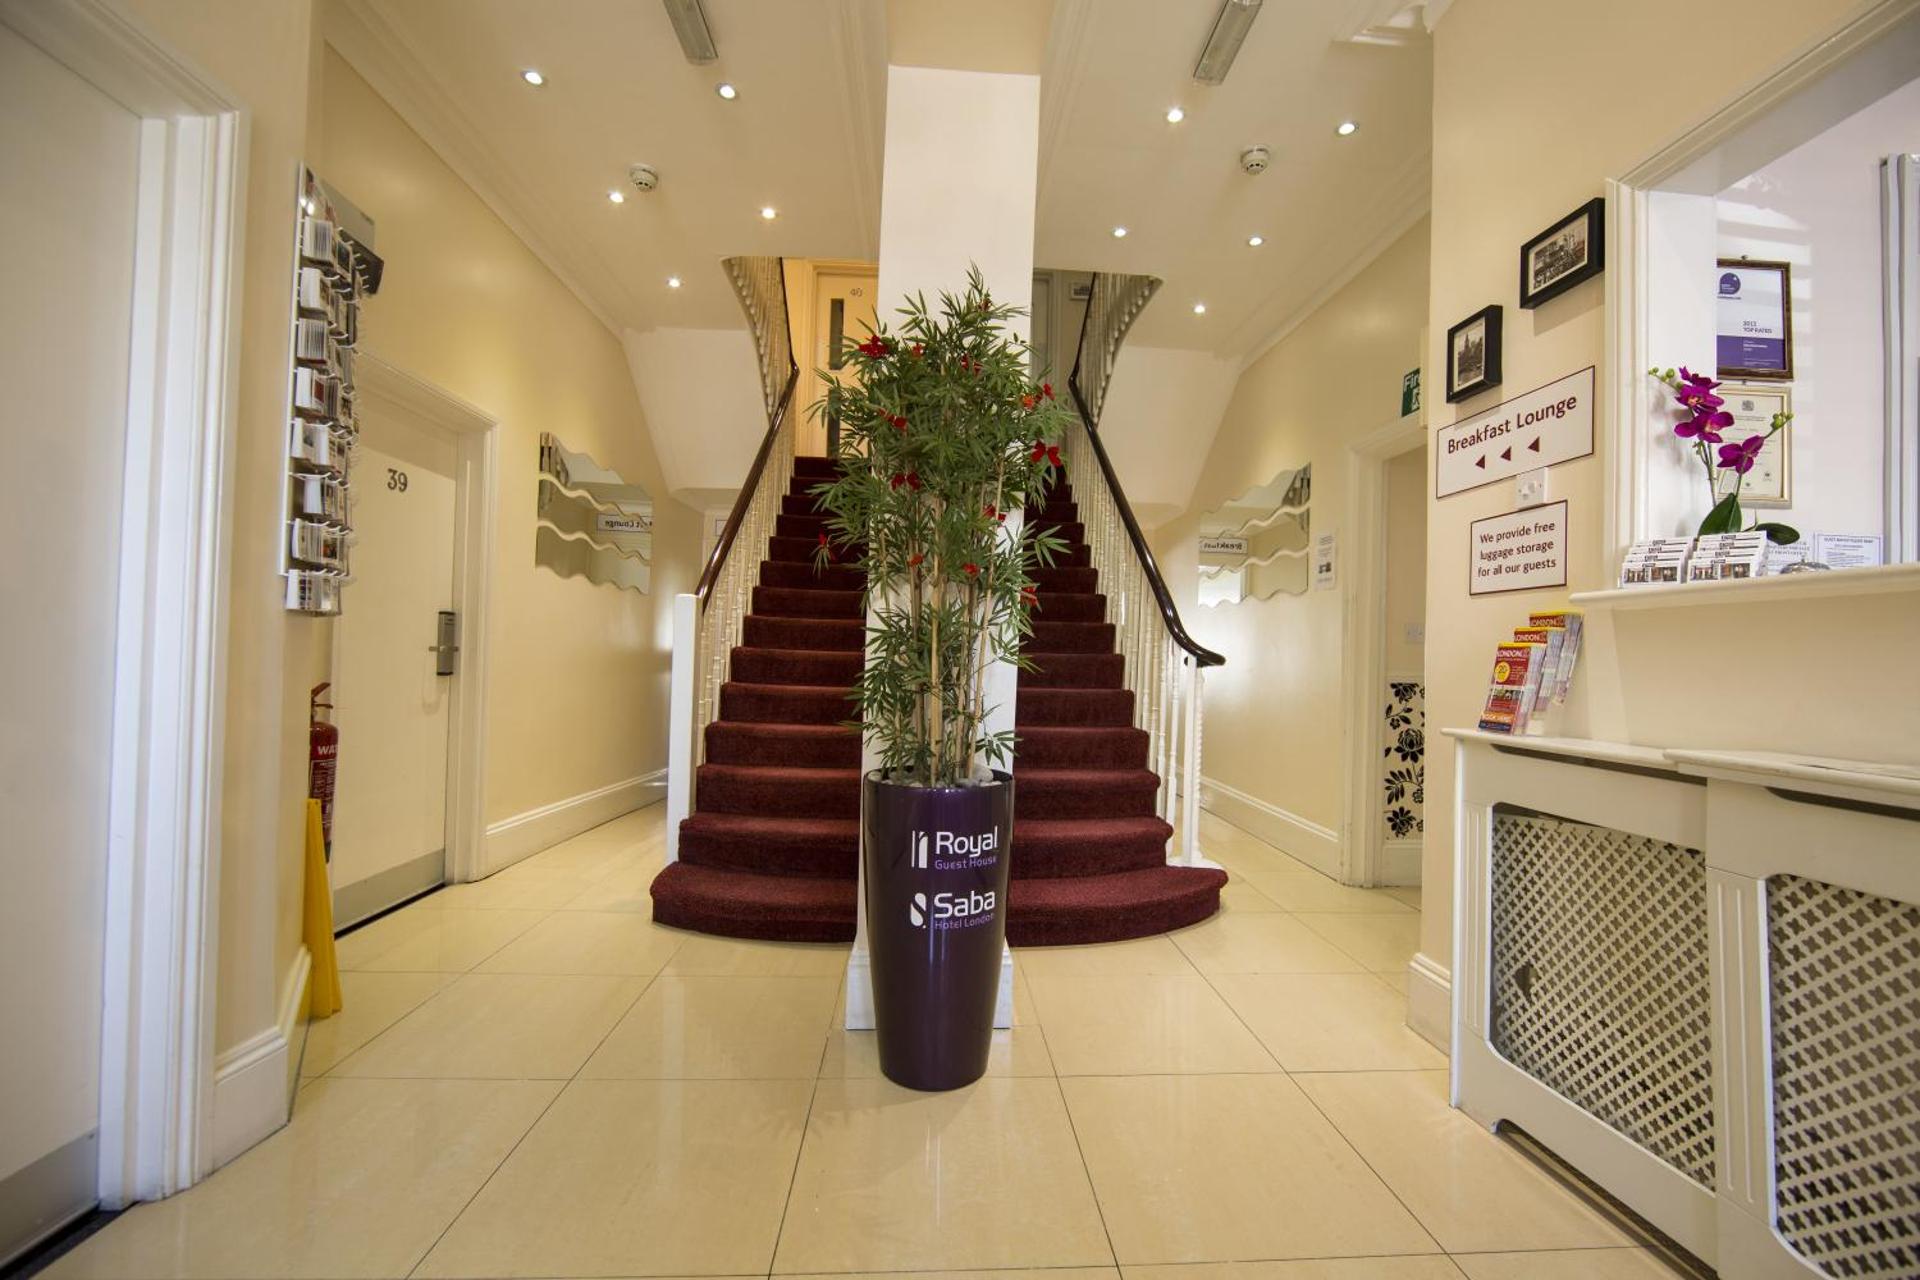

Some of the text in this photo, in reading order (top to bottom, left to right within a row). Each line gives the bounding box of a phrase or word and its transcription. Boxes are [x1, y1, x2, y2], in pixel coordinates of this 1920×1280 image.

[1448, 396, 1577, 454] Breakfast Lounge
[387, 468, 408, 493] 39
[1480, 522, 1555, 543] We provide free
[1480, 540, 1554, 562] luggage storage
[1478, 559, 1556, 577] for all our guests
[936, 825, 998, 858] Royal
[935, 855, 997, 870] Guest House
[934, 890, 996, 919] Saba
[935, 912, 995, 930] Hotel London
